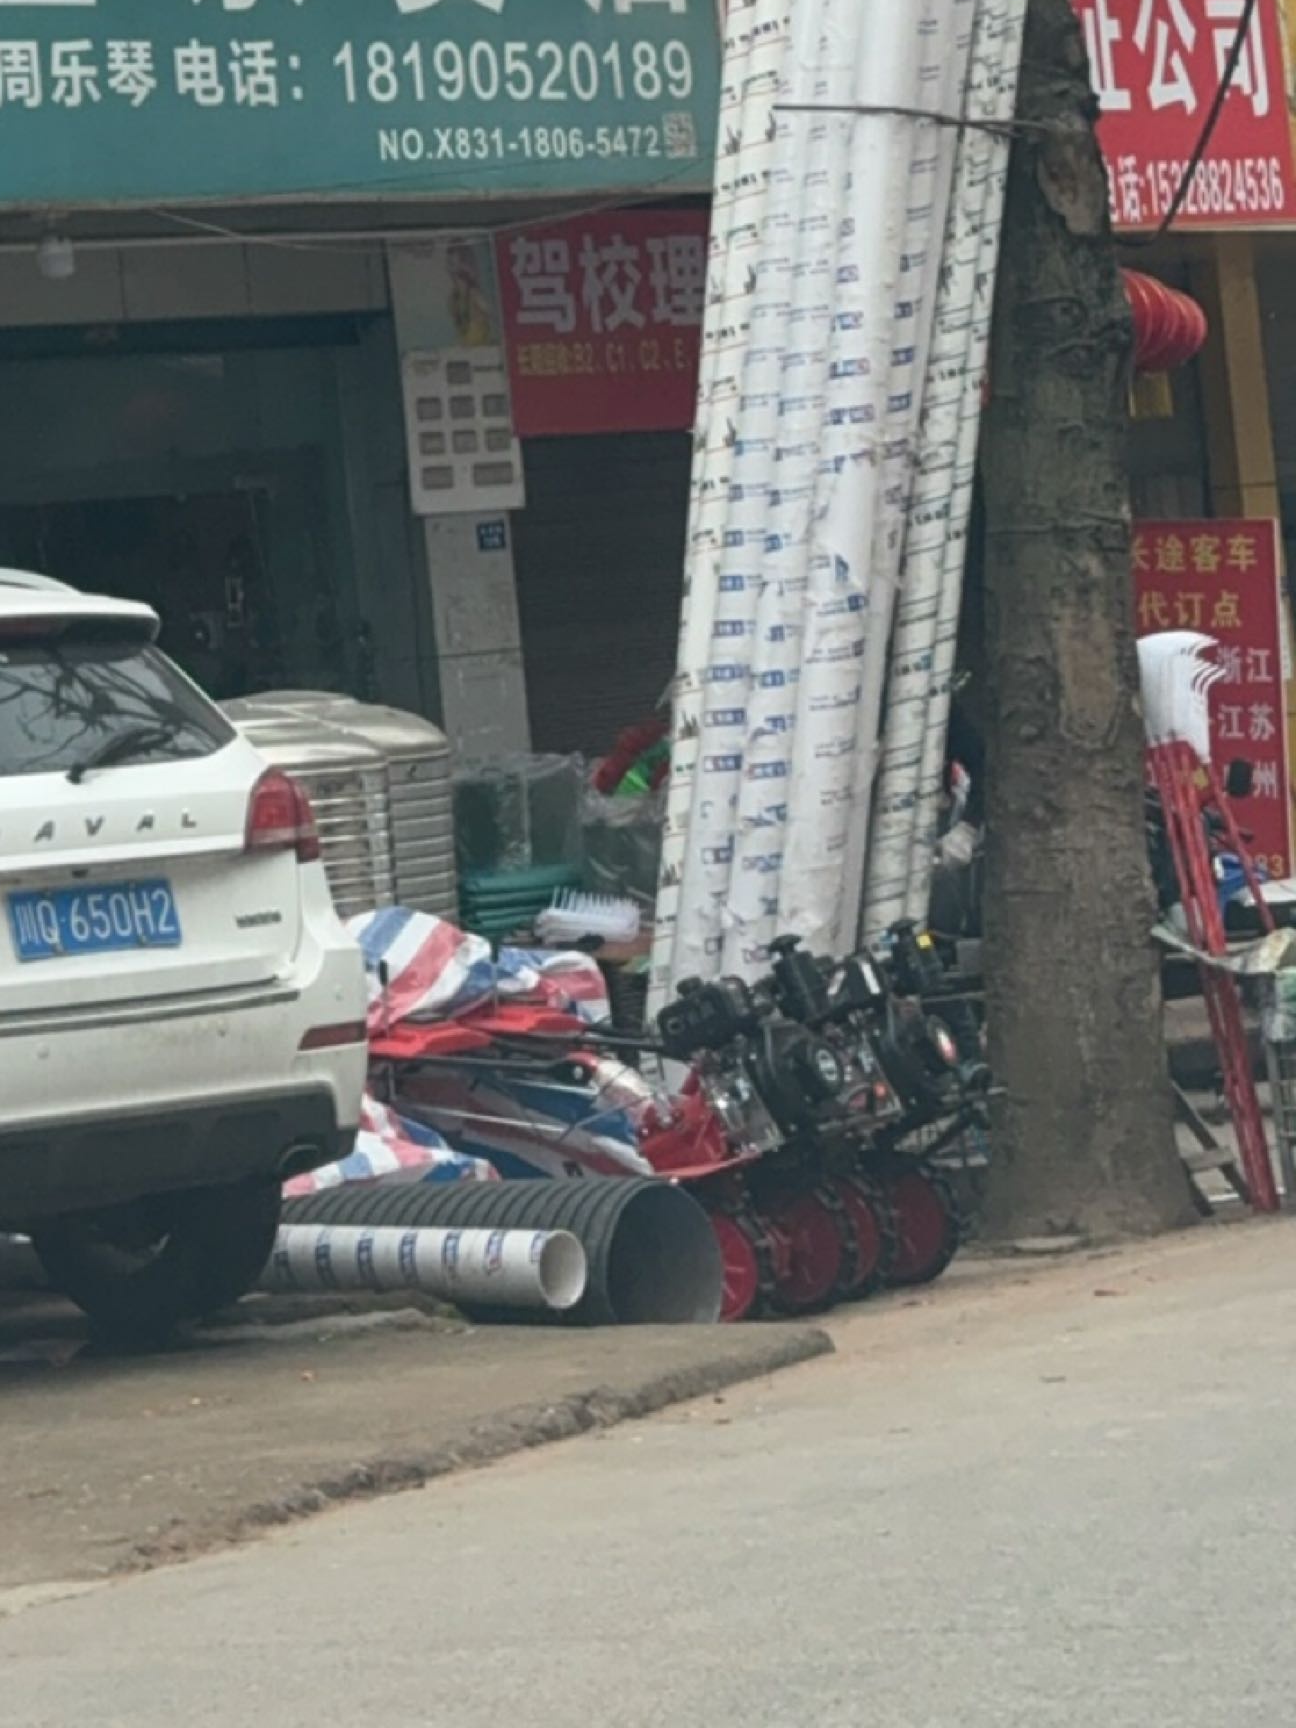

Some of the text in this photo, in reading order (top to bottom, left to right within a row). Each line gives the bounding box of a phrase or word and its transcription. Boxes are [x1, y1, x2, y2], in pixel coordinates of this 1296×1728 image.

[378, 127, 661, 162] NO.X831-1806-5472
[510, 234, 705, 334] 驾校理
[1139, 589, 1243, 628] 代订点
[1216, 646, 1273, 684] 浙江
[1217, 703, 1276, 741] 江苏
[1223, 760, 1279, 800] 州
